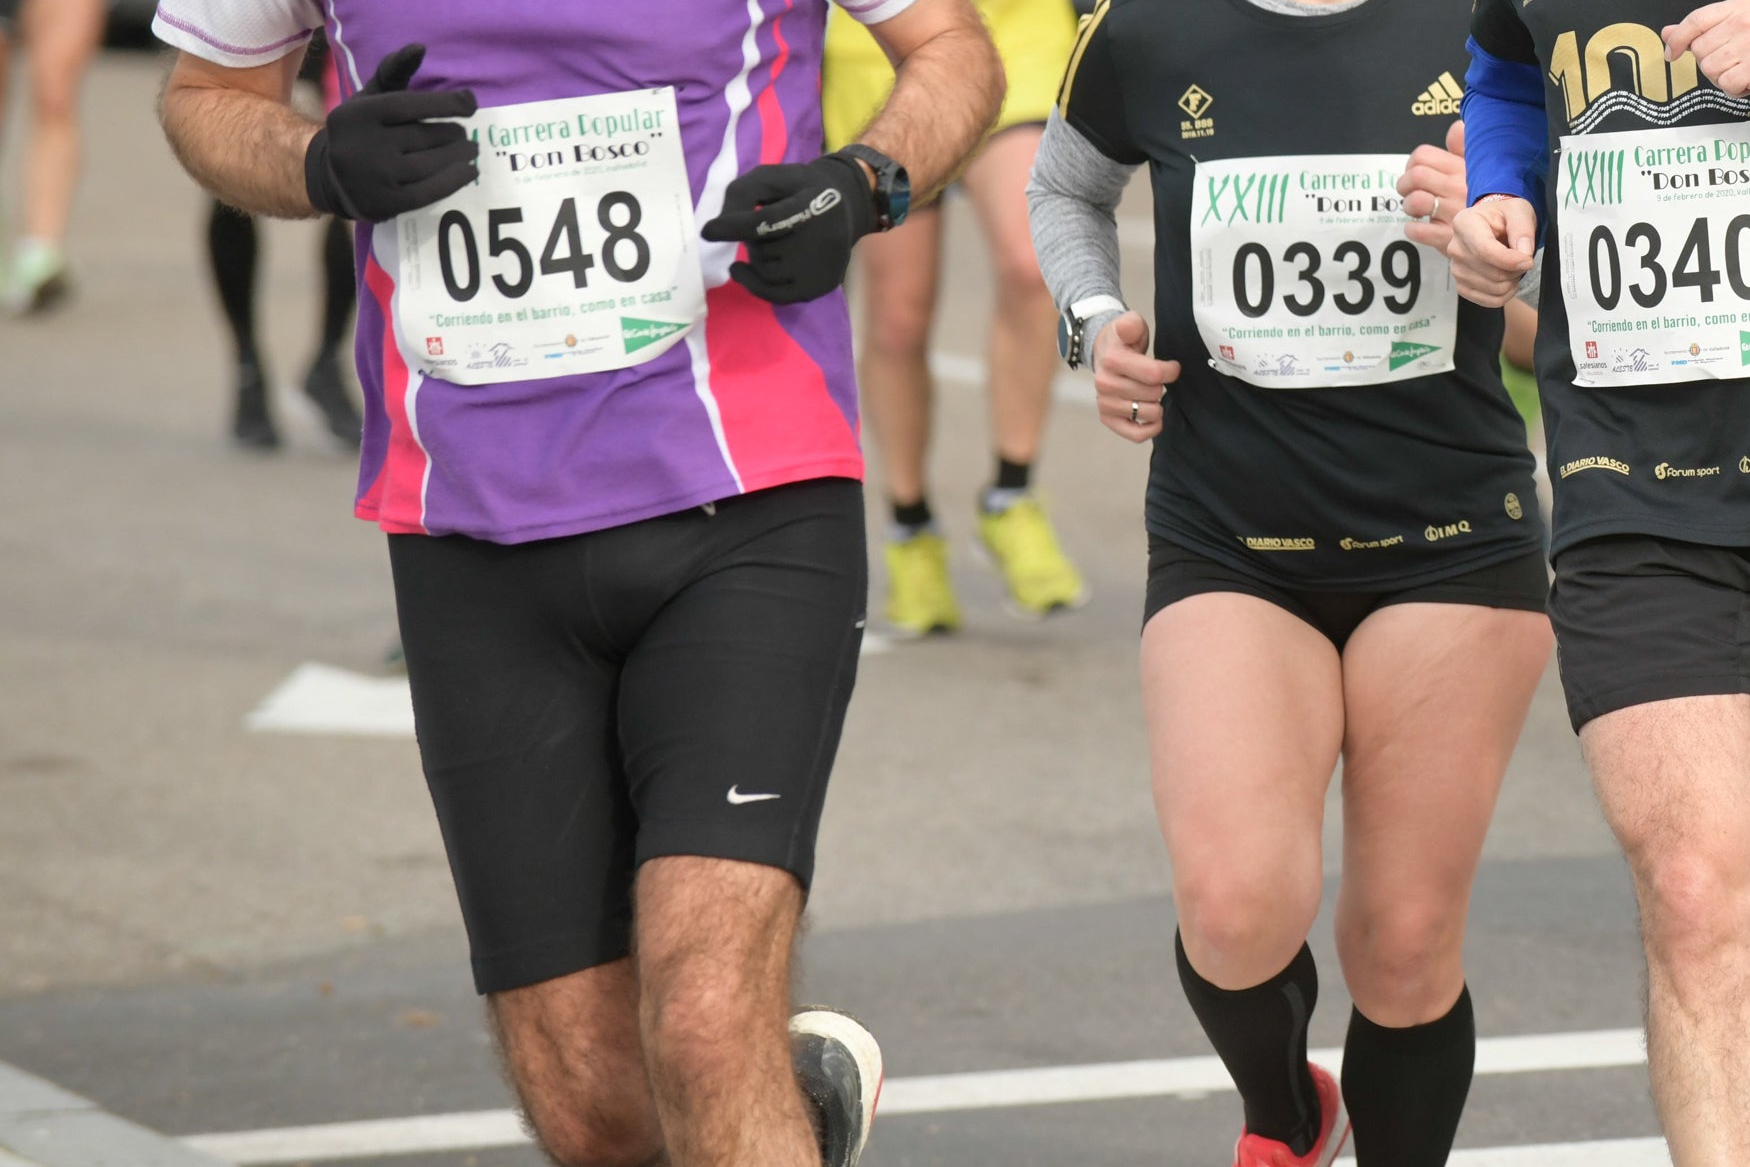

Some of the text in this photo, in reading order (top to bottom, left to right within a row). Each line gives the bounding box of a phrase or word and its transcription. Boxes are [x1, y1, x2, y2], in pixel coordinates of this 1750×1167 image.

[1411, 99, 1461, 117] adida
[488, 108, 665, 147] Carrera Popular
[1634, 145, 1707, 168] Carrera
[1300, 170, 1371, 191] Carrera
[1564, 148, 1624, 210] XXIII
[1201, 172, 1290, 227] XXIII
[1656, 194, 1662, 202] 9
[1663, 193, 1672, 202] de
[1673, 190, 1703, 201] febrero
[1705, 190, 1714, 199] de
[1716, 188, 1735, 199] 2020,
[438, 190, 651, 302] 0548
[1232, 240, 1421, 318] 0339
[497, 311, 513, 324] en
[516, 308, 528, 322] el
[580, 299, 616, 314] como
[621, 295, 637, 308] en
[1287, 326, 1301, 338] en
[1304, 325, 1314, 338] el
[1318, 323, 1356, 338] barrio,
[1359, 324, 1390, 335] como
[1393, 323, 1406, 334] en
[1636, 320, 1649, 330] en
[1651, 317, 1661, 329] el
[1663, 315, 1701, 329] barrio,
[1705, 313, 1737, 326] como
[1579, 362, 1607, 370] salesianos
[1566, 456, 1596, 472] DIARIO
[1597, 456, 1630, 473] VASCO
[1697, 466, 1720, 478] sport
[1246, 537, 1281, 547] DIARIO
[1282, 537, 1315, 547] VASCO
[1380, 535, 1404, 548] sport
